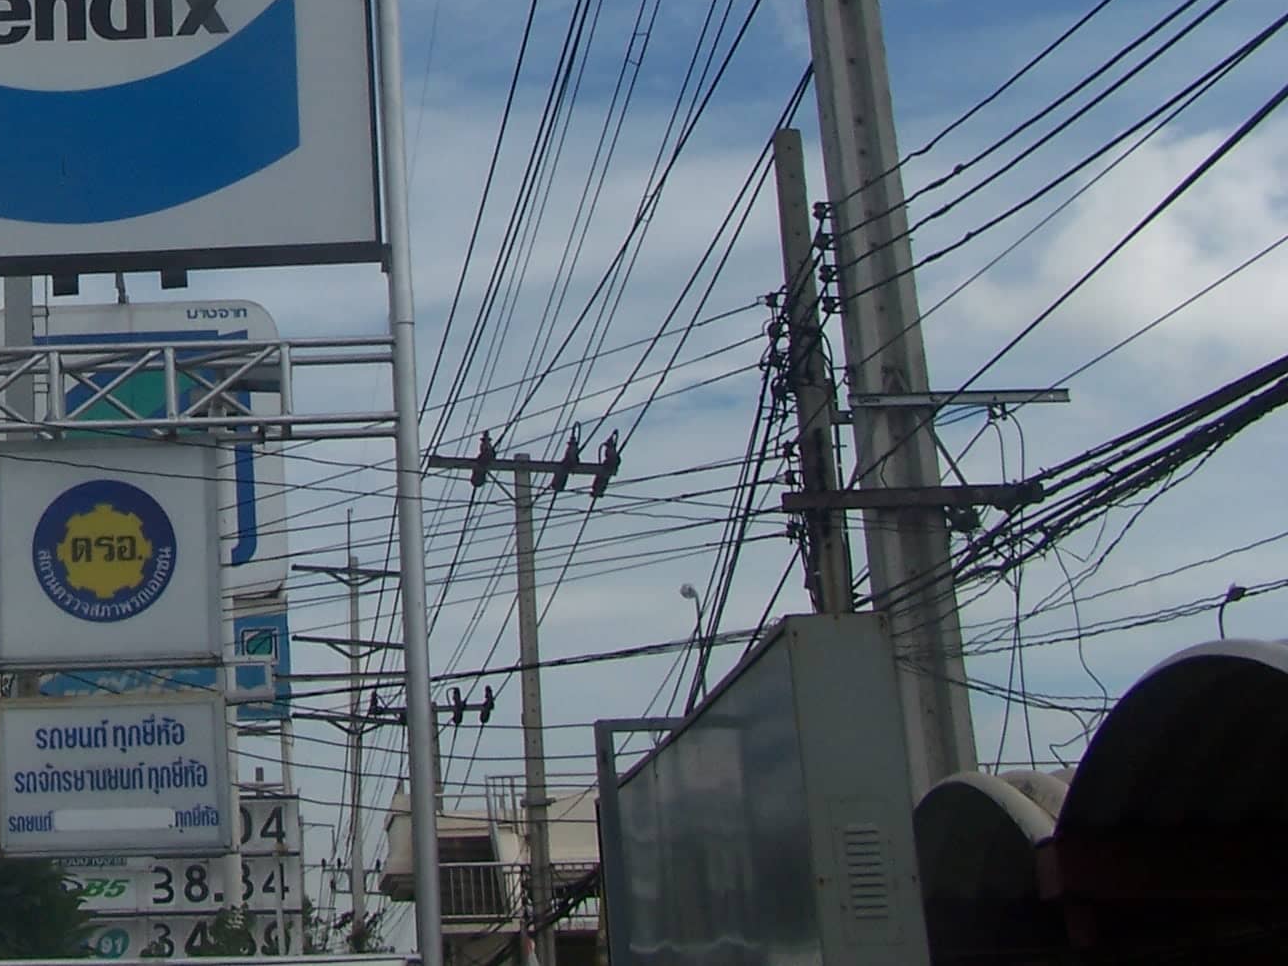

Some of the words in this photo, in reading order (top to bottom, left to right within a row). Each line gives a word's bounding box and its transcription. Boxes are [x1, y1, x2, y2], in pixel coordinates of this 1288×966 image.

[35, 718, 109, 750] รถยนต์
[112, 713, 186, 754] ทุกยี่ห้อ
[14, 761, 145, 794] รถจักรยานยนต์
[147, 756, 209, 795] ทุกยี่ห้อ
[8, 810, 55, 833] รถยนต์
